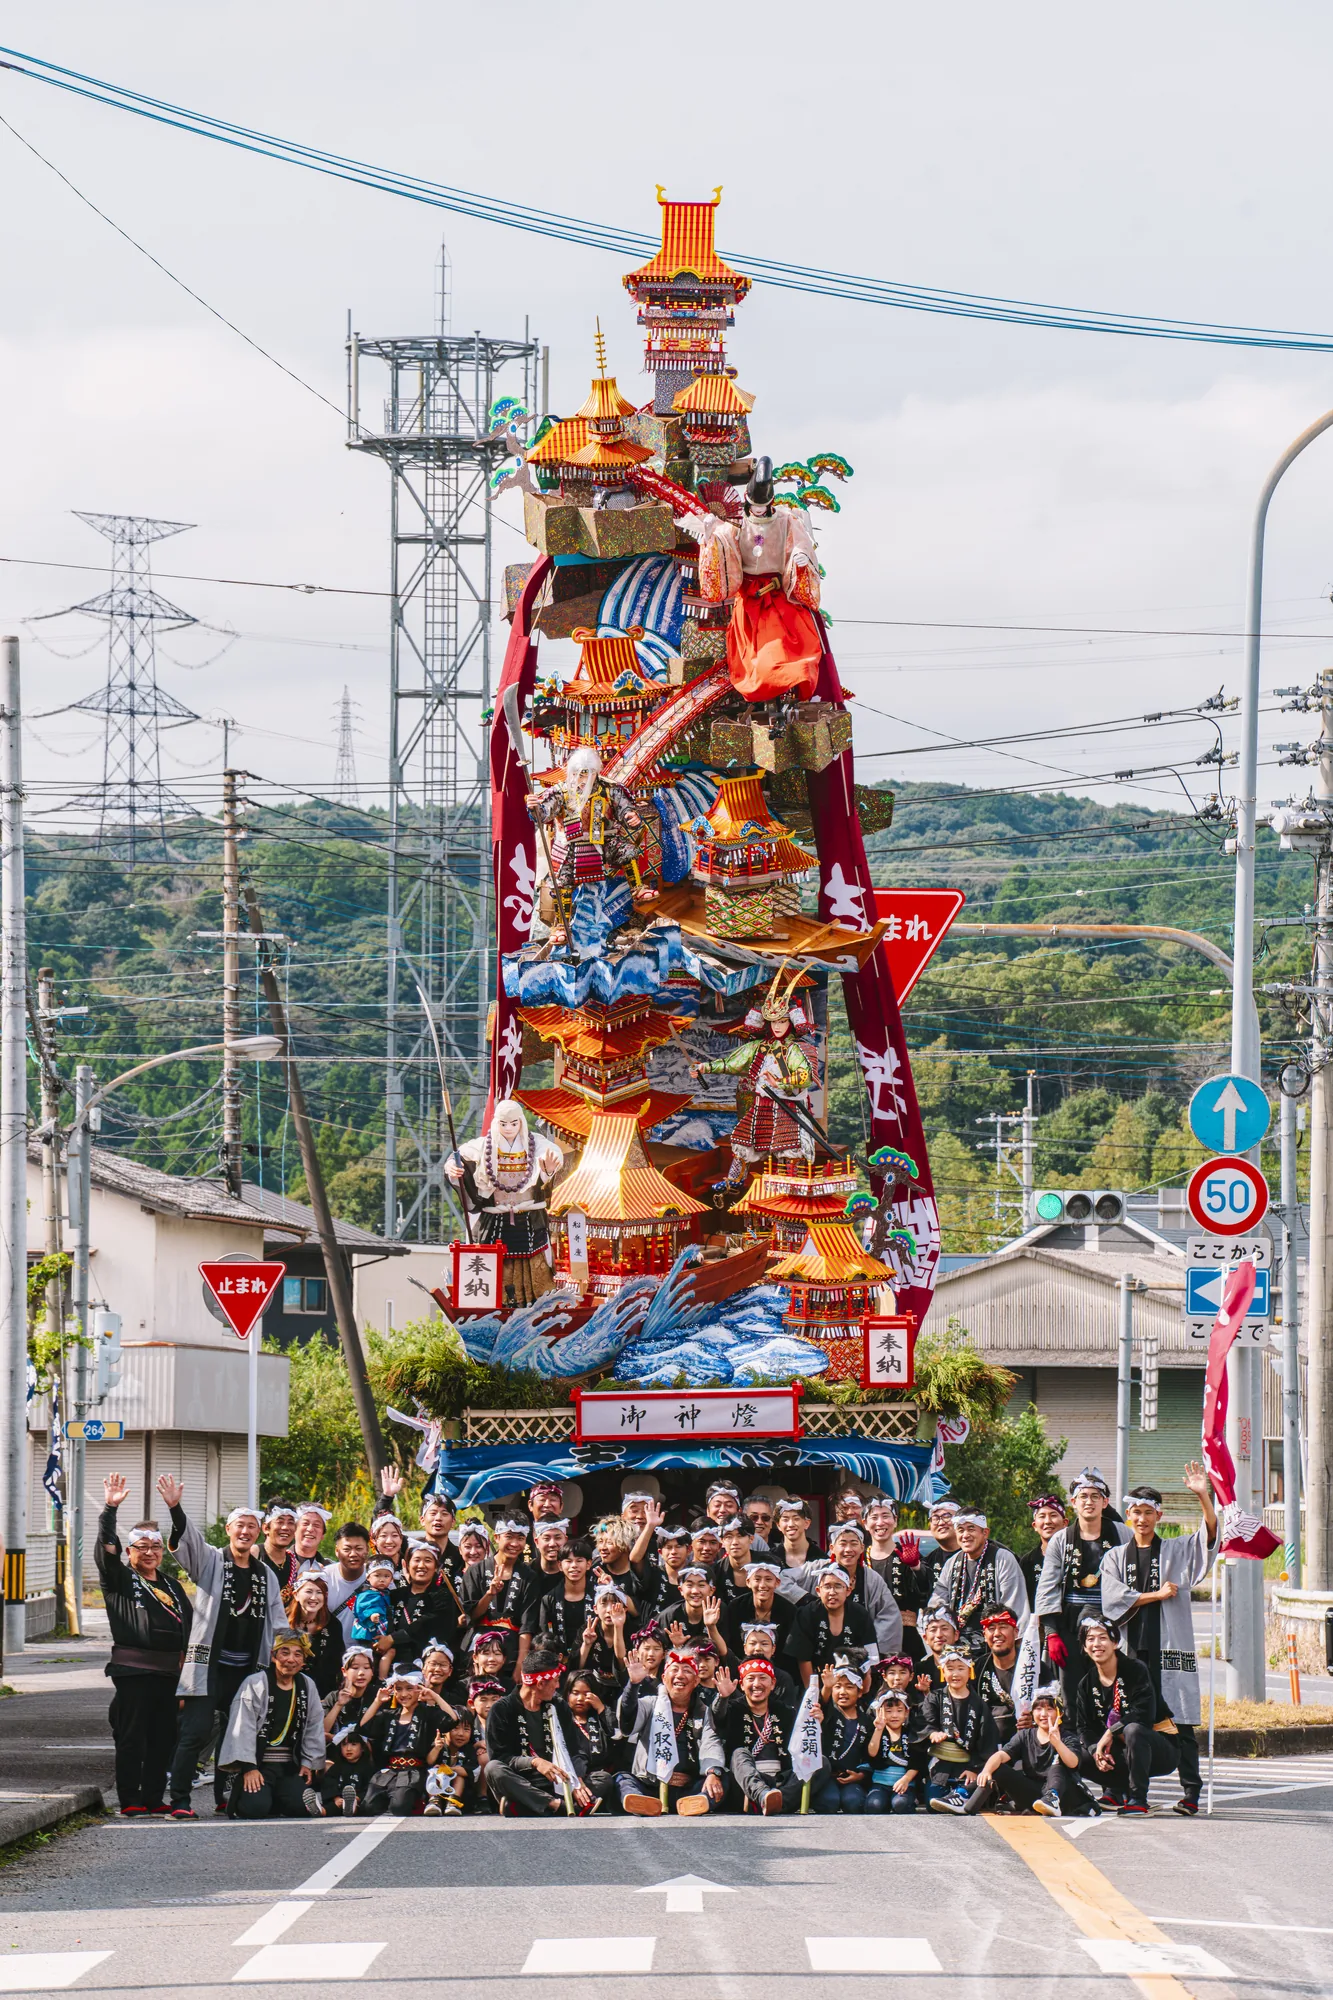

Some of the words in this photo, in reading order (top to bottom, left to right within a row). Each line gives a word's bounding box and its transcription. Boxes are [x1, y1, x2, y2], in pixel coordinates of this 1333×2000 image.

[882, 914, 933, 942] まれ
[1206, 1179, 1249, 1214] 50
[1193, 1244, 1264, 1261] ここから
[217, 1276, 268, 1294] 止まれ
[464, 1255, 492, 1297] 奉納
[1191, 1322, 1264, 1341] こで
[876, 1332, 903, 1374] 奉納
[85, 1424, 104, 1436] 264
